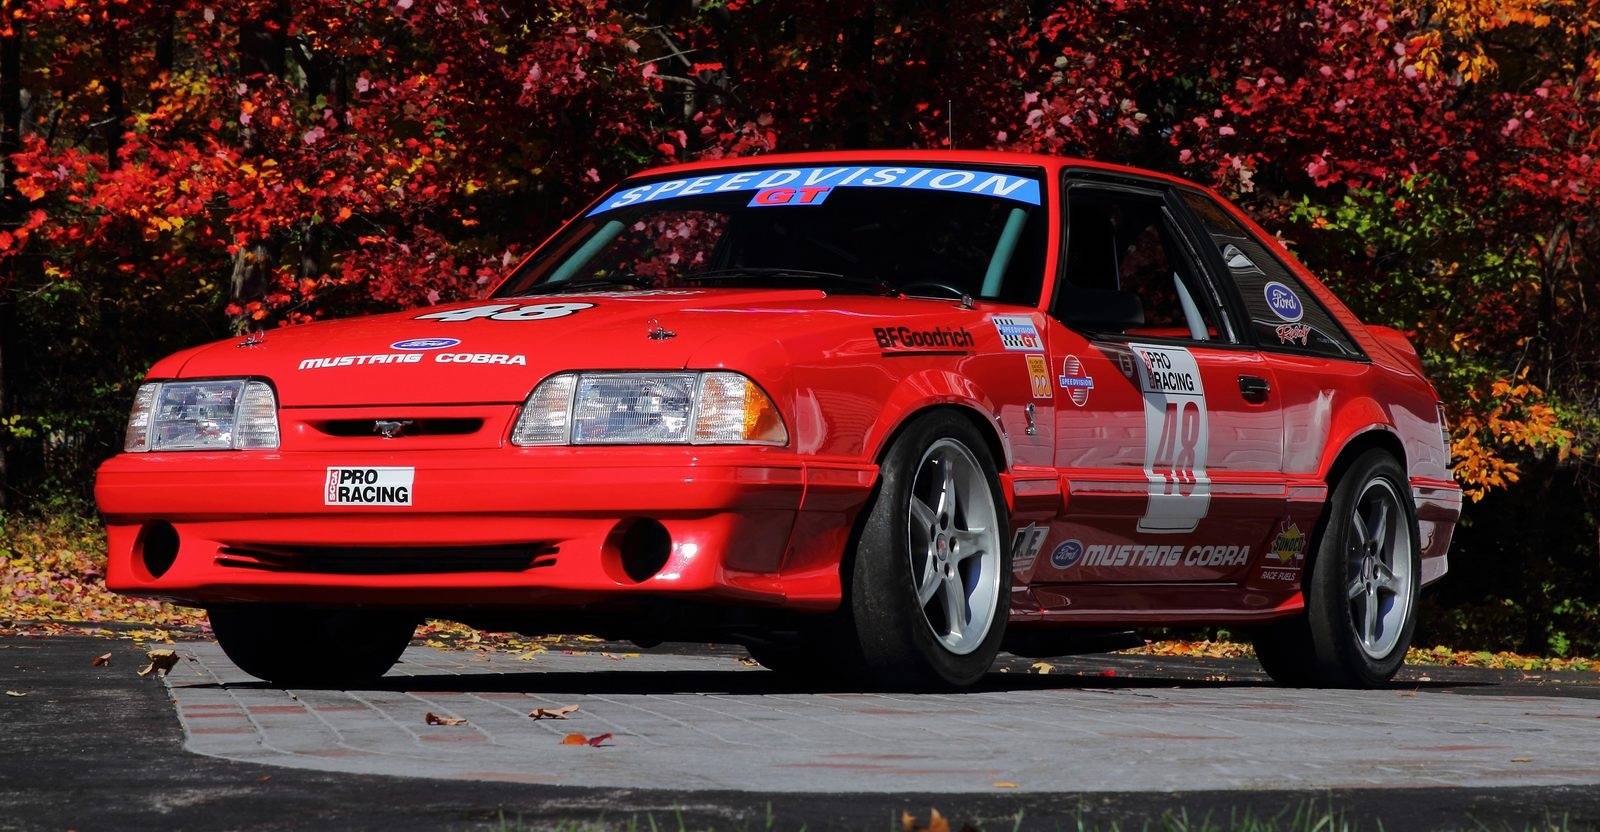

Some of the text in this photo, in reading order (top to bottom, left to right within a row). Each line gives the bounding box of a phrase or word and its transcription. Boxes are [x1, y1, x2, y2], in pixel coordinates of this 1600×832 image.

[611, 167, 1027, 208] SPEEDVISION
[753, 187, 830, 205] GT
[1272, 288, 1297, 310] Ford
[412, 302, 594, 322] 48
[873, 327, 975, 348] BFGoodrich
[1021, 334, 1040, 348] GT
[298, 353, 527, 370] MUSTANG COBRA
[1147, 352, 1171, 369] PRO
[1061, 378, 1092, 386] SPEEDVISION
[1153, 372, 1194, 391] RACING
[1152, 401, 1199, 497] 48
[340, 469, 378, 484] PRO
[338, 486, 409, 502] RACING
[1081, 545, 1250, 567] MUSTANG COBRA
[1262, 571, 1296, 581] RACE FUELS
